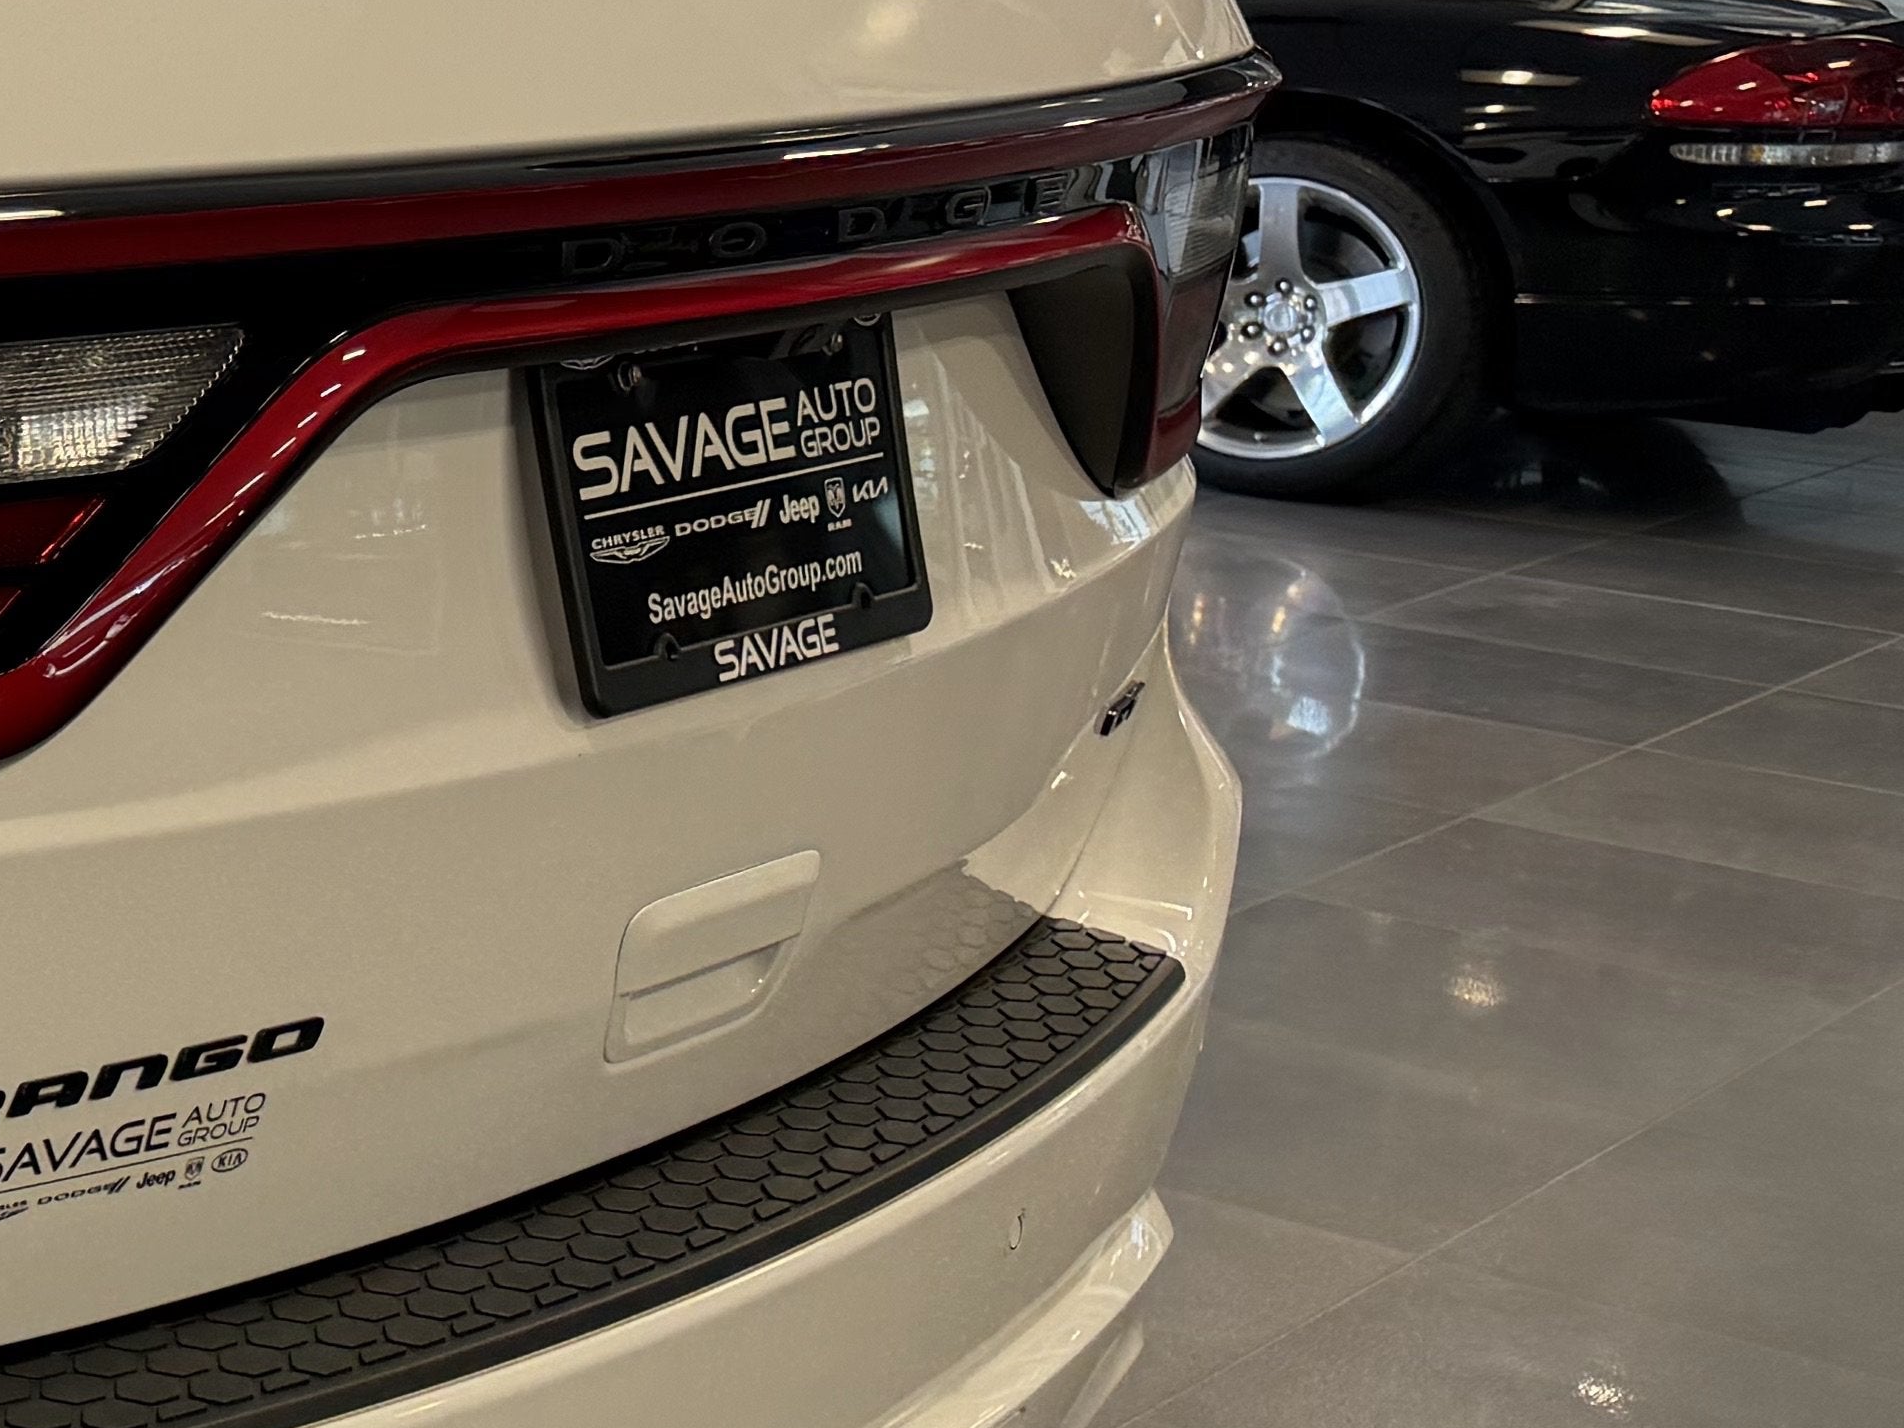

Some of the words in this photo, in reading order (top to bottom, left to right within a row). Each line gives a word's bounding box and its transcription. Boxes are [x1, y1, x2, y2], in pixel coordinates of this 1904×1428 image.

[560, 174, 1070, 275] DODGE
[796, 377, 877, 427] AUTO
[572, 397, 796, 501] SAVAGE
[800, 416, 881, 459] GROUP
[852, 476, 889, 505] KIA
[675, 507, 758, 538] DODGE
[779, 494, 820, 525] Jeep
[591, 524, 665, 550] CHRYSLER
[648, 548, 863, 625] SavageAutoGroup.com
[713, 613, 840, 683] SAVAGE
[182, 1092, 267, 1129] AUTO
[176, 1114, 261, 1149] GROUP
[216, 1151, 244, 1170] KIA
[135, 1169, 177, 1190] Jeep
